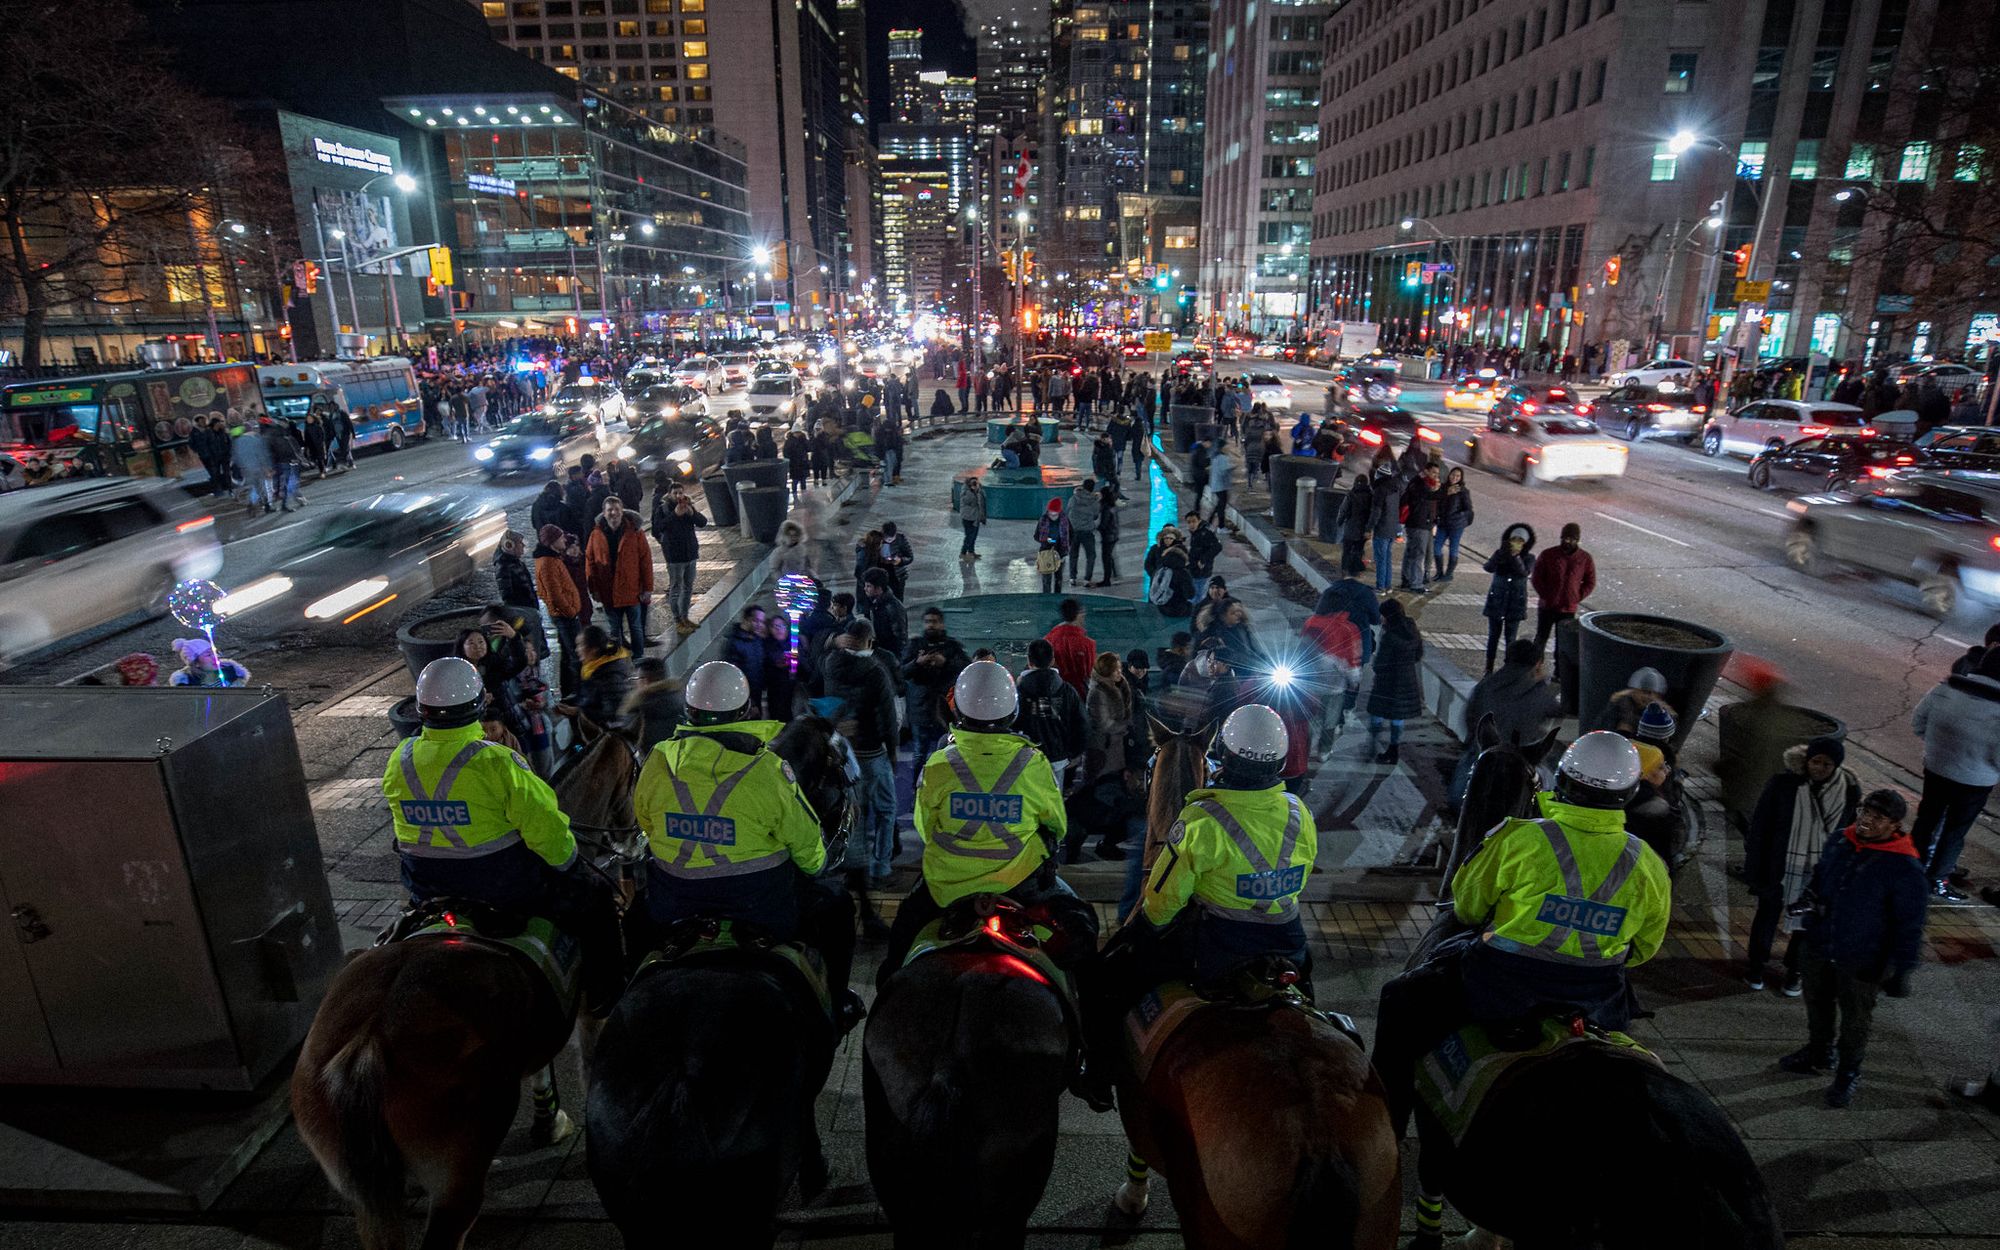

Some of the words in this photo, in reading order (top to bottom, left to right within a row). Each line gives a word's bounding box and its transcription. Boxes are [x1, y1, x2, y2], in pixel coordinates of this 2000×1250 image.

[1239, 748, 1278, 761] POLICE
[403, 805, 468, 824] POLICE
[952, 797, 1020, 818] POLICE
[668, 817, 733, 841] POLICE
[1238, 871, 1302, 896] POLICE
[1541, 900, 1622, 931] POLICE
